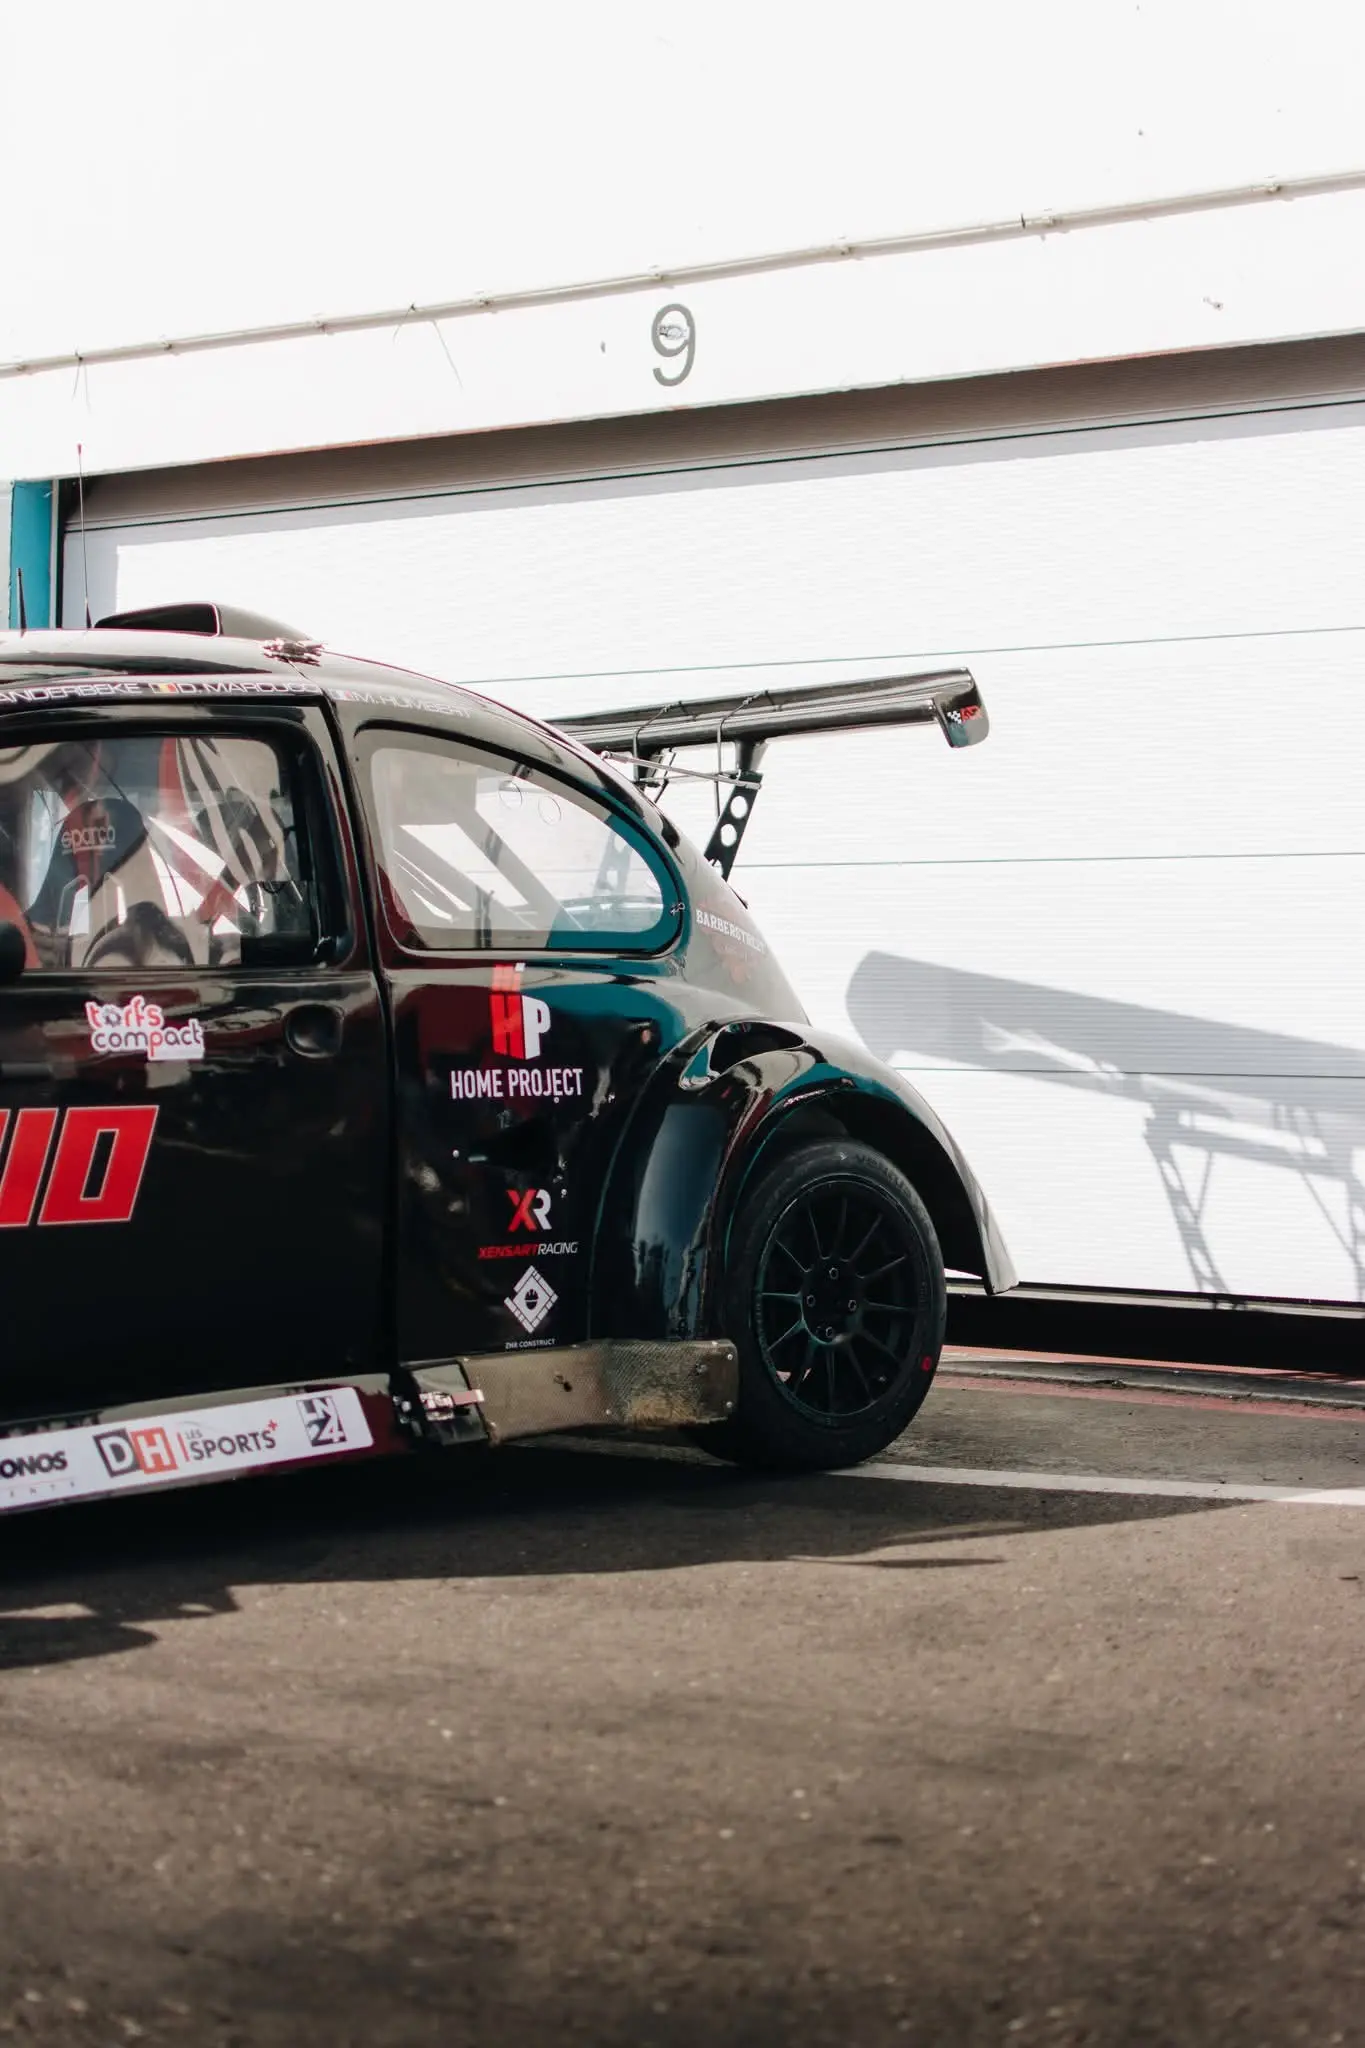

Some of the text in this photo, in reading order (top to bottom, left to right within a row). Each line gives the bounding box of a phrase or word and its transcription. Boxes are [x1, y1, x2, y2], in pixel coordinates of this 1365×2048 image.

[651, 303, 696, 387] 9
[61, 825, 116, 855] sparco
[93, 1021, 202, 1057] compact
[489, 993, 551, 1061] HP
[450, 1067, 584, 1100] HOME PROJECT
[506, 1188, 553, 1232] XR
[518, 1338, 556, 1349] CONSTRUCT
[0, 1450, 68, 1480] ONOS
[94, 1427, 179, 1478] DH
